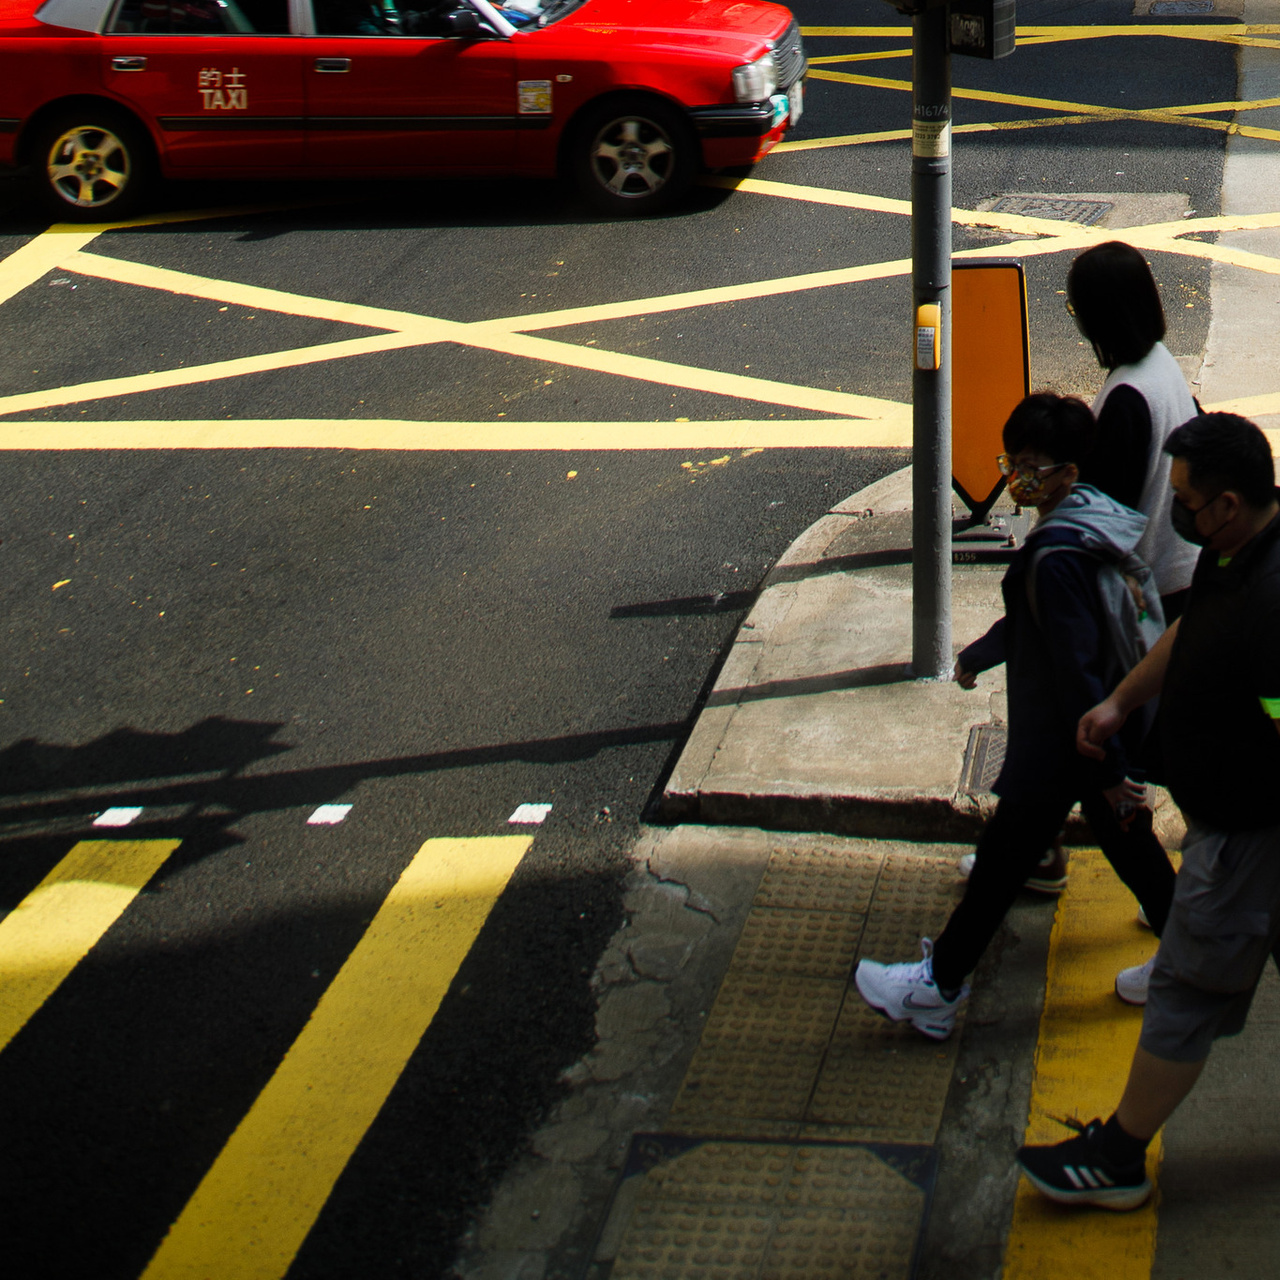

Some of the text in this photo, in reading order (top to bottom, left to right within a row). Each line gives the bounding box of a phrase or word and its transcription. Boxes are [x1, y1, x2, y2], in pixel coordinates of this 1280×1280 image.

[198, 67, 247, 88] 的士
[198, 89, 248, 110] TAXI
[914, 104, 949, 117] H167/4
